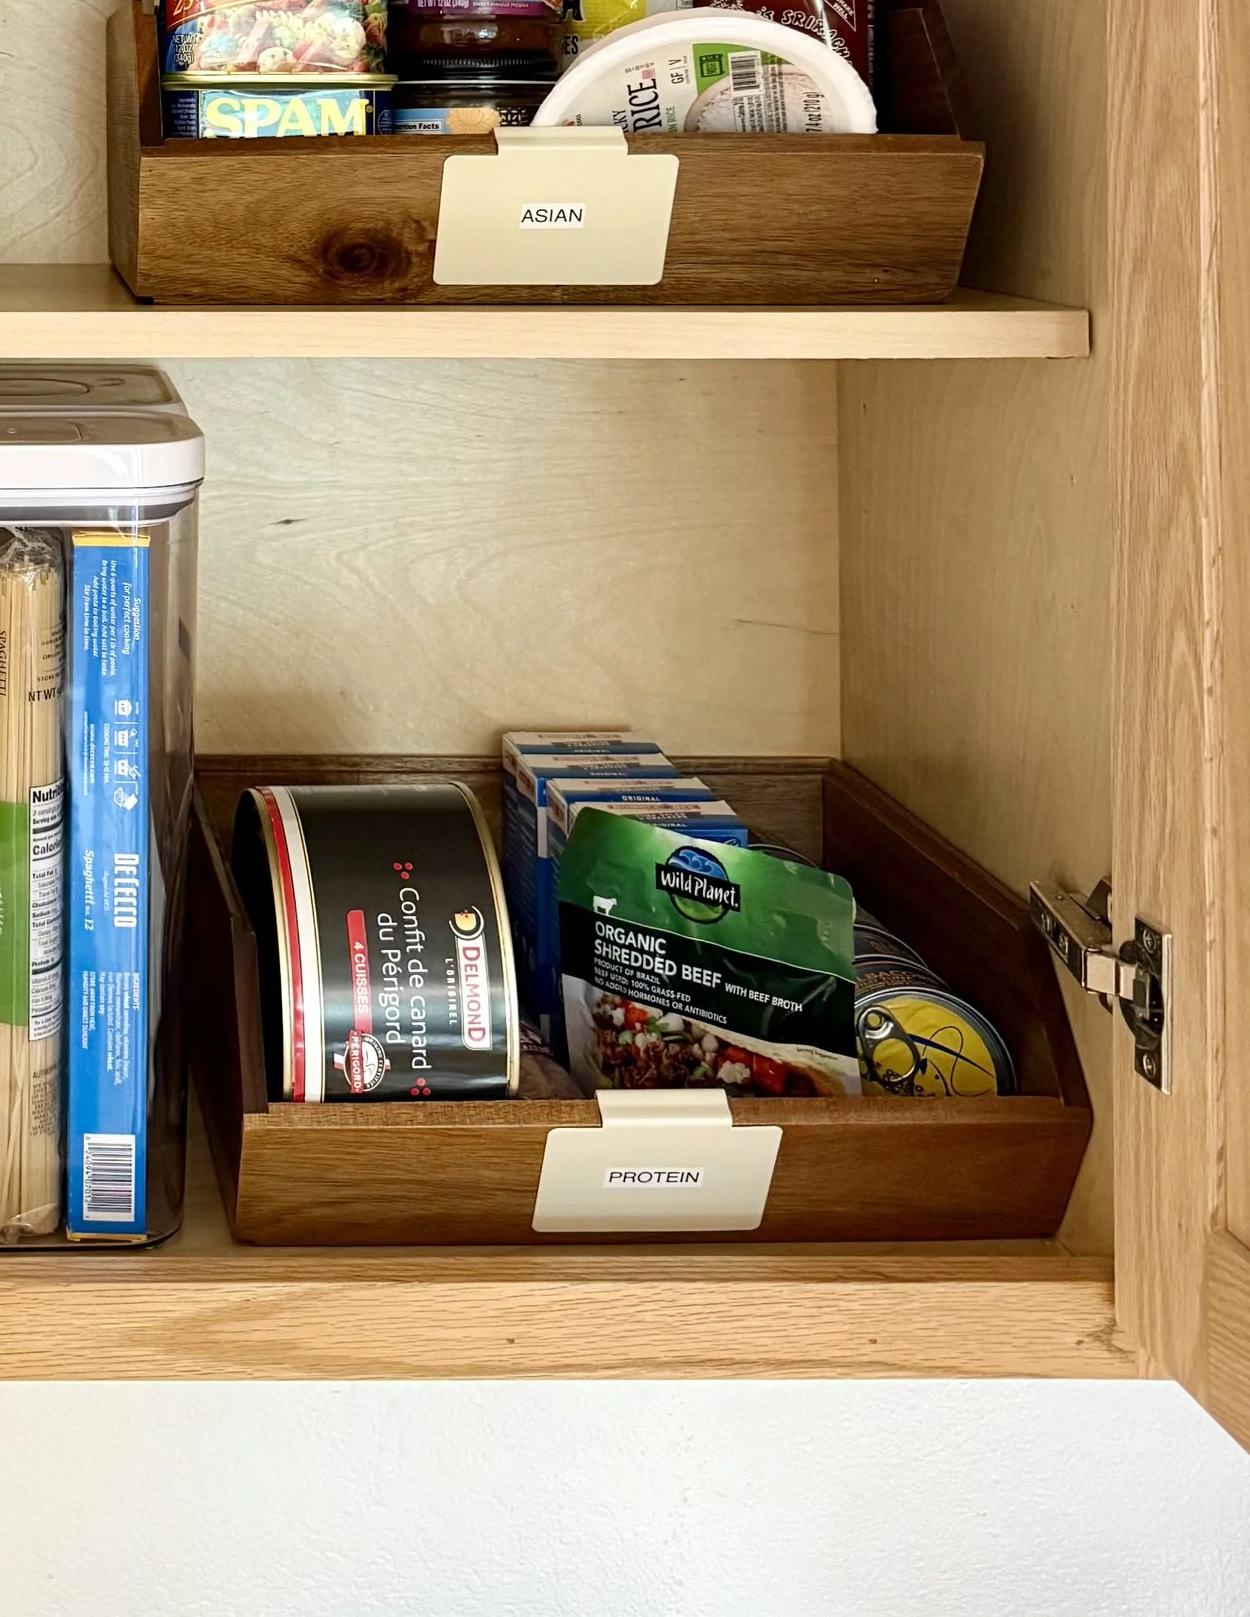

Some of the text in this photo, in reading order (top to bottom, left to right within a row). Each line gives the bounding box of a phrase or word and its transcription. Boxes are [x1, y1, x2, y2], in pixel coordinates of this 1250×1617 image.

[671, 72, 684, 84] GF
[204, 98, 369, 138] SPAM
[627, 79, 662, 132] RICE
[418, 122, 439, 130] Facts
[521, 208, 583, 223] ASIAN
[122, 583, 132, 654] for perfect cooking
[132, 598, 141, 640] Suggestion
[83, 850, 95, 930] Spaghetti 12
[660, 870, 737, 908] Wild Planet
[595, 921, 666, 955] ORGANIC
[353, 942, 370, 1015] 4 CUISSES
[377, 913, 406, 1044] du Périgord
[399, 887, 432, 1070] Confit de canard
[594, 958, 661, 985] PRODUCT OF BRAZIL
[594, 939, 803, 1012] SHREDDED BEEF WITH BEEF BROTH
[631, 979, 650, 991] 100%
[650, 985, 691, 1003] GRASS-FED
[628, 988, 670, 1008] HORMONES
[671, 1001, 683, 1011] OR
[684, 1005, 727, 1025] ANTIBIOTICS
[350, 1036, 363, 1092] PÉRIGORD
[608, 1171, 700, 1183] PROTEIN
